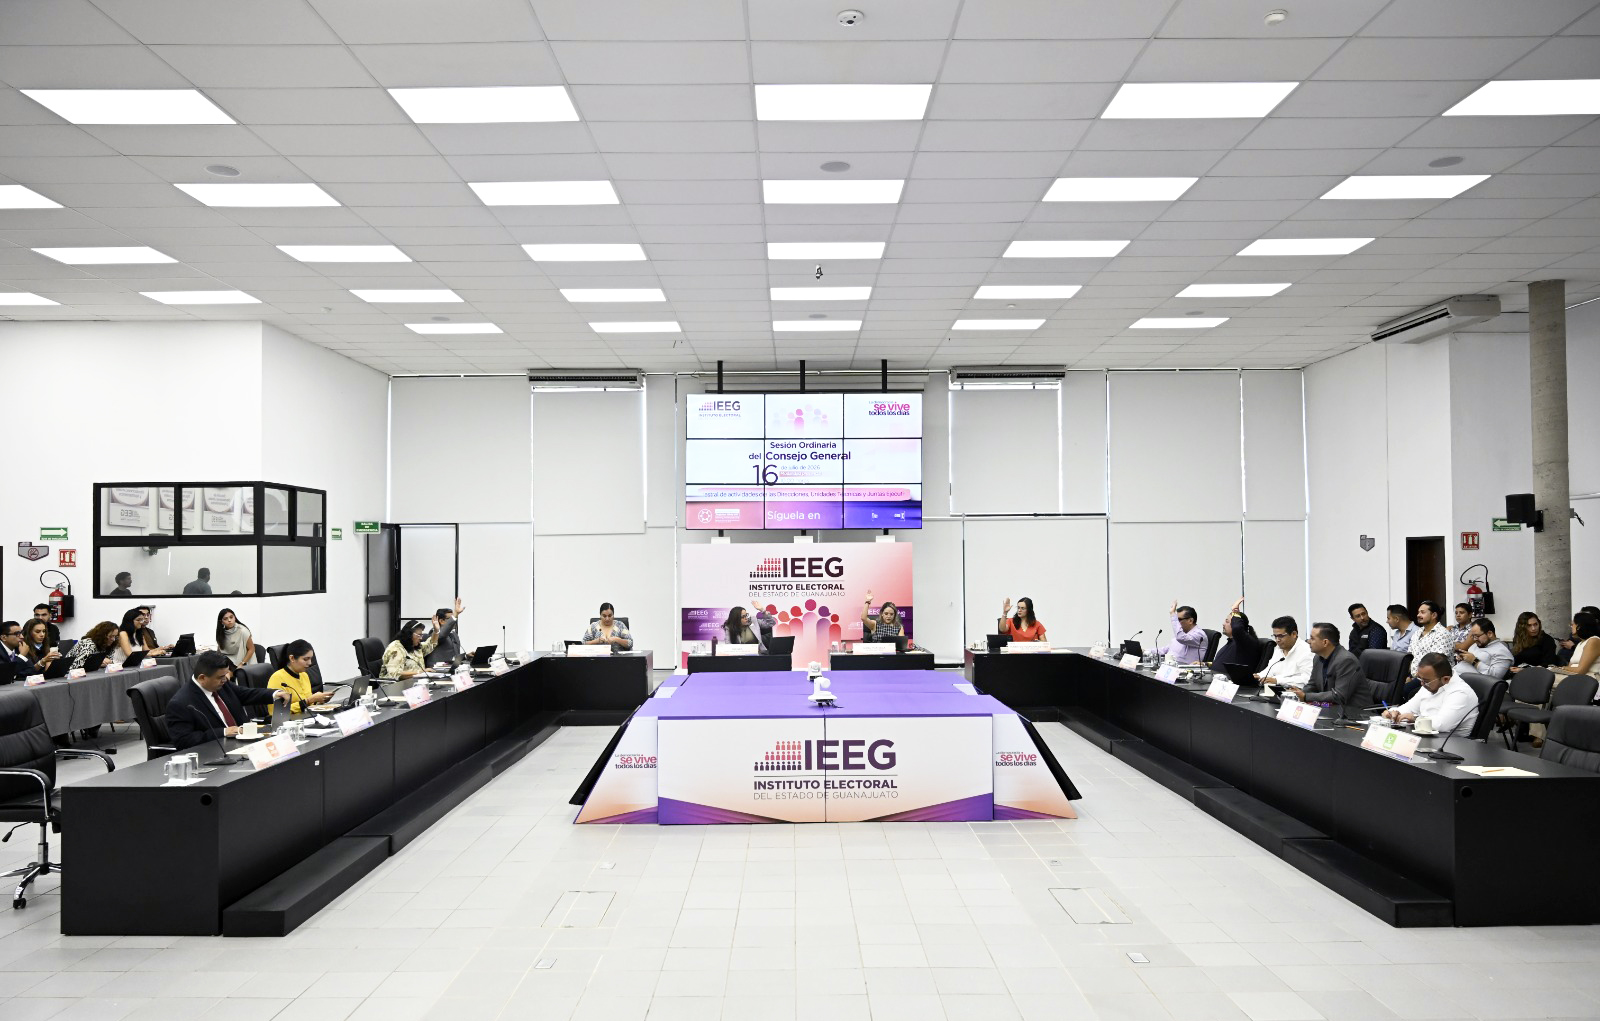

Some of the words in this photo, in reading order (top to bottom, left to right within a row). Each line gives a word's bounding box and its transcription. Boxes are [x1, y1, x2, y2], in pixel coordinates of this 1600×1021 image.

[713, 400, 741, 411] IEEG
[873, 403, 887, 411] se
[887, 401, 911, 411] vive
[770, 441, 797, 449] Sesión
[798, 441, 837, 449] Ordinaria
[748, 452, 762, 460] del
[765, 451, 808, 462] Consejo
[810, 451, 852, 461] General
[752, 464, 779, 487] 16
[767, 510, 804, 521] Síguela
[782, 557, 844, 578] IEEG
[620, 756, 633, 764] se
[634, 754, 657, 763] vive
[804, 739, 897, 771] IEEG
[1000, 753, 1013, 762] se
[1014, 752, 1037, 762] vive
[753, 780, 820, 790] INSTITUTO
[823, 779, 898, 789] ELECTORAL
[753, 792, 772, 800] DEL
[775, 791, 814, 800] ESTADO
[816, 791, 829, 799] DE
[832, 790, 899, 799] GUANAJUATO
